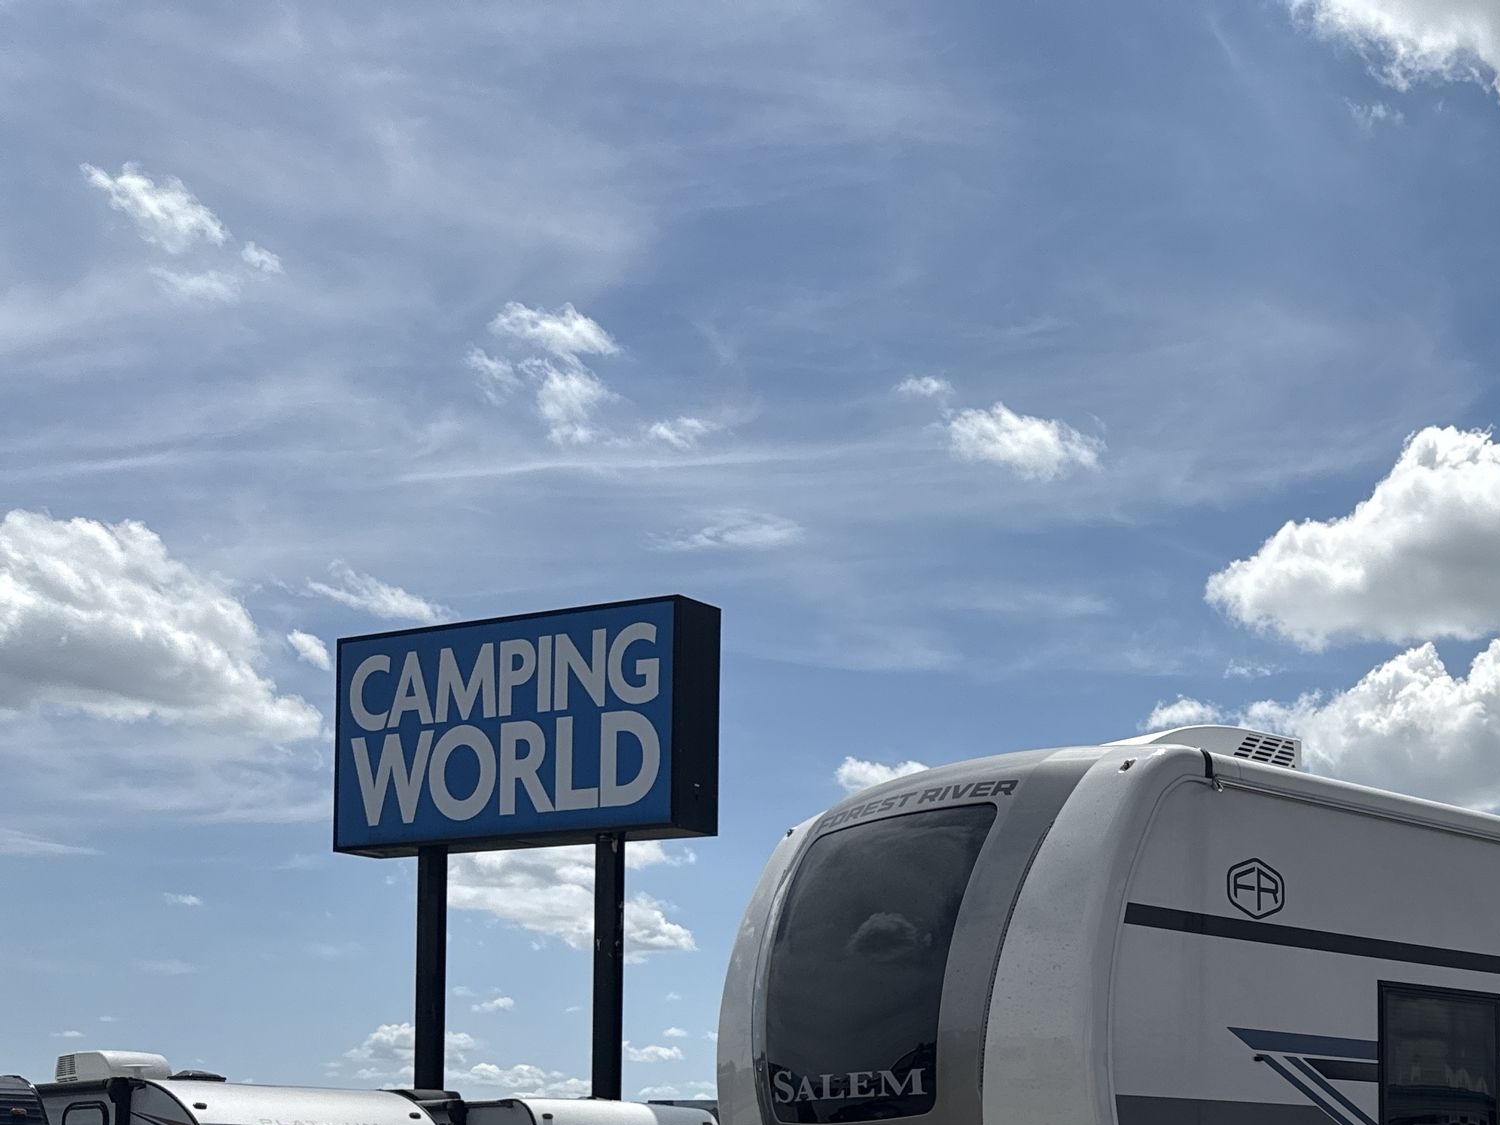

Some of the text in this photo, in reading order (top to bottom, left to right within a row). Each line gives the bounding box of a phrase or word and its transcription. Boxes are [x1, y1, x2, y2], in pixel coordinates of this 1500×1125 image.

[349, 622, 660, 732] CAMPING
[350, 710, 661, 827] WORLD
[815, 779, 1020, 834] FOREST RIVER
[773, 1067, 928, 1104] SALEM
